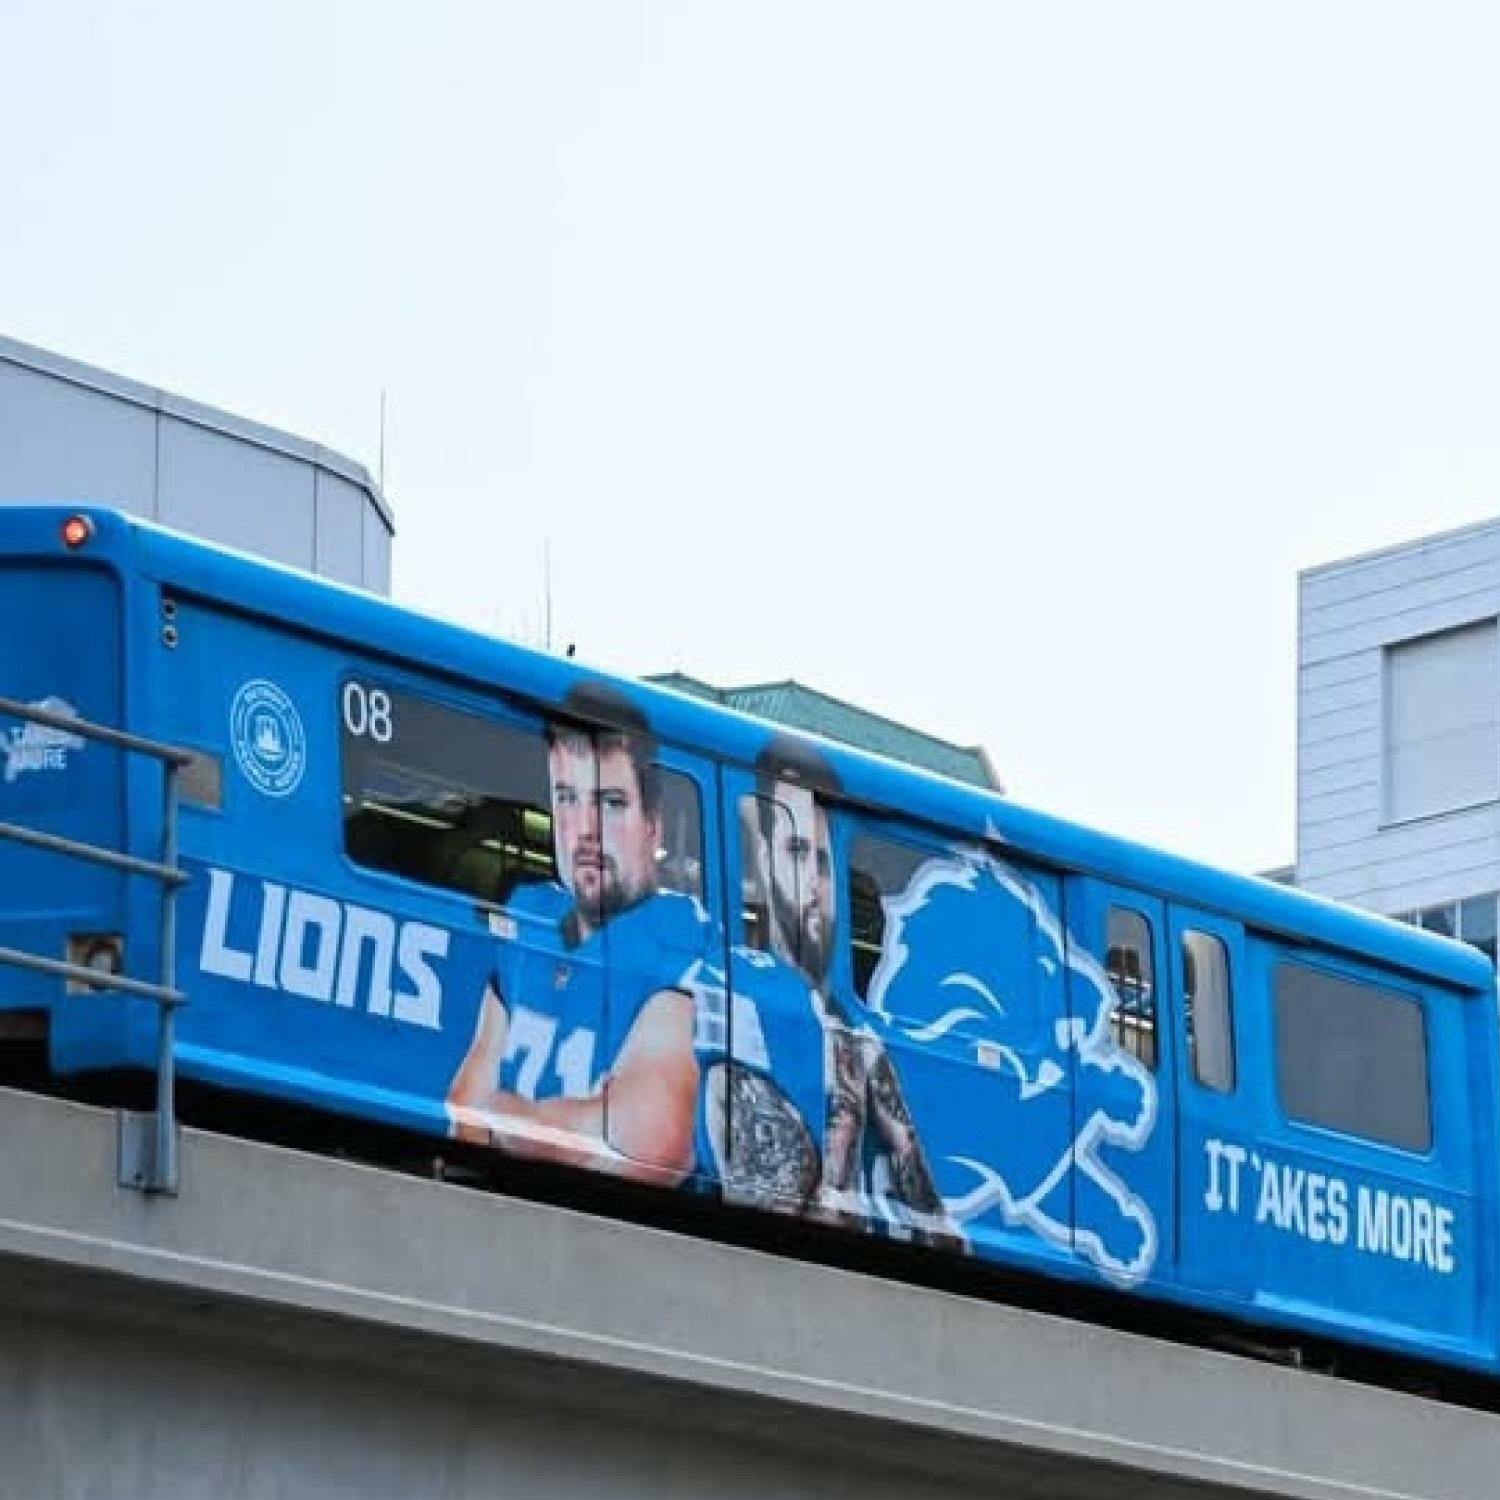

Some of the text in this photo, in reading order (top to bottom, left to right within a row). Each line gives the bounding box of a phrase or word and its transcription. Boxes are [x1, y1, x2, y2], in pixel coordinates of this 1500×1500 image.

[343, 681, 393, 743] 08
[200, 867, 452, 1031] LIONS
[1205, 1138, 1247, 1214] IT
[1357, 1186, 1455, 1273] MORE
